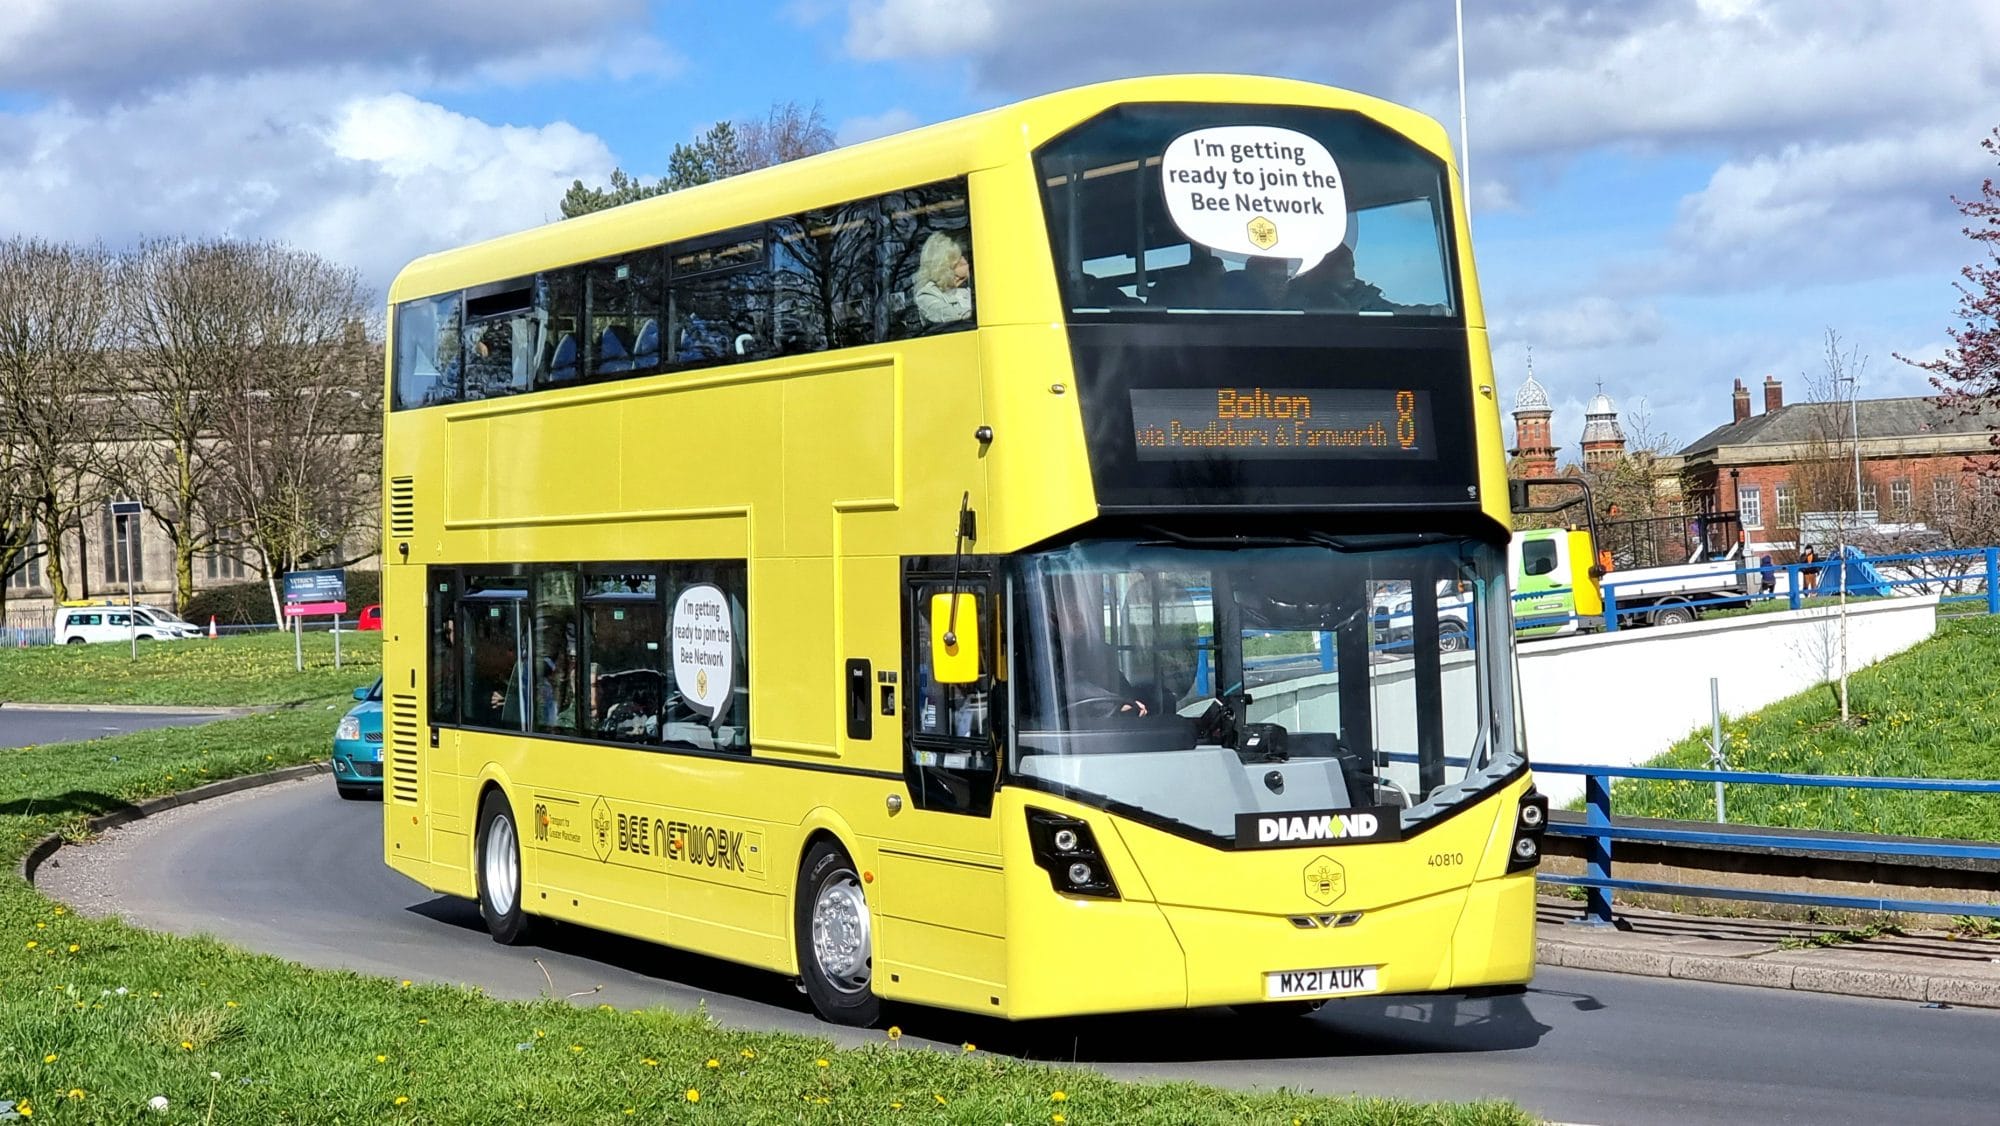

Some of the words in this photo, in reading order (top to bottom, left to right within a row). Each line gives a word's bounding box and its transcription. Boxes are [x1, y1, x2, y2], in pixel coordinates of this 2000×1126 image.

[1194, 138, 1225, 157] I'm
[1230, 141, 1306, 165] getting
[1169, 166, 1227, 190] ready
[1233, 168, 1255, 185] to
[1259, 167, 1298, 191] join
[1302, 170, 1337, 189] the
[1191, 192, 1230, 211] Bee
[1235, 193, 1325, 215] Network
[1217, 387, 1312, 419] Bolton
[1395, 390, 1415, 447] 8
[1137, 423, 1165, 447] via
[1170, 420, 1269, 447] Pendlebury
[1275, 424, 1290, 447] &
[1294, 420, 1388, 447] Farnworth
[694, 600, 720, 622] getting
[674, 624, 694, 645] ready
[694, 625, 703, 640] to
[703, 626, 717, 645] join
[717, 626, 730, 643] the
[680, 647, 693, 664] Bee
[694, 648, 724, 667] Network
[617, 813, 650, 855] BEE
[653, 818, 745, 873] NETWORK
[1427, 852, 1464, 867] 40810
[1280, 971, 1323, 993] MX21
[1329, 969, 1365, 988] AUK
